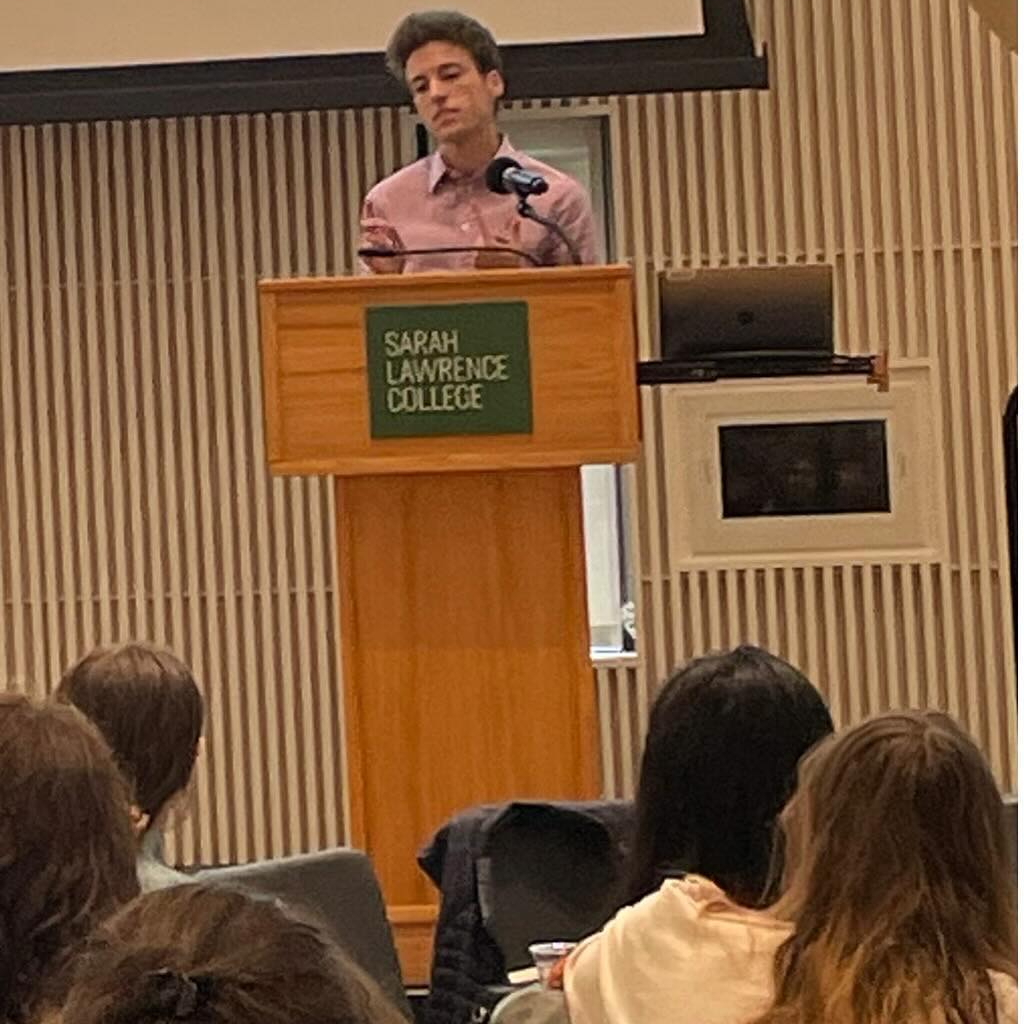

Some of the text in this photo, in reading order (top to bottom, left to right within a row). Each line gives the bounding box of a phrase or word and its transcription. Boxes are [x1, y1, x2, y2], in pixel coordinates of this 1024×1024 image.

[384, 330, 458, 356] SARAH
[386, 354, 509, 385] LAWRENCE
[387, 384, 483, 412] COLLEGE
